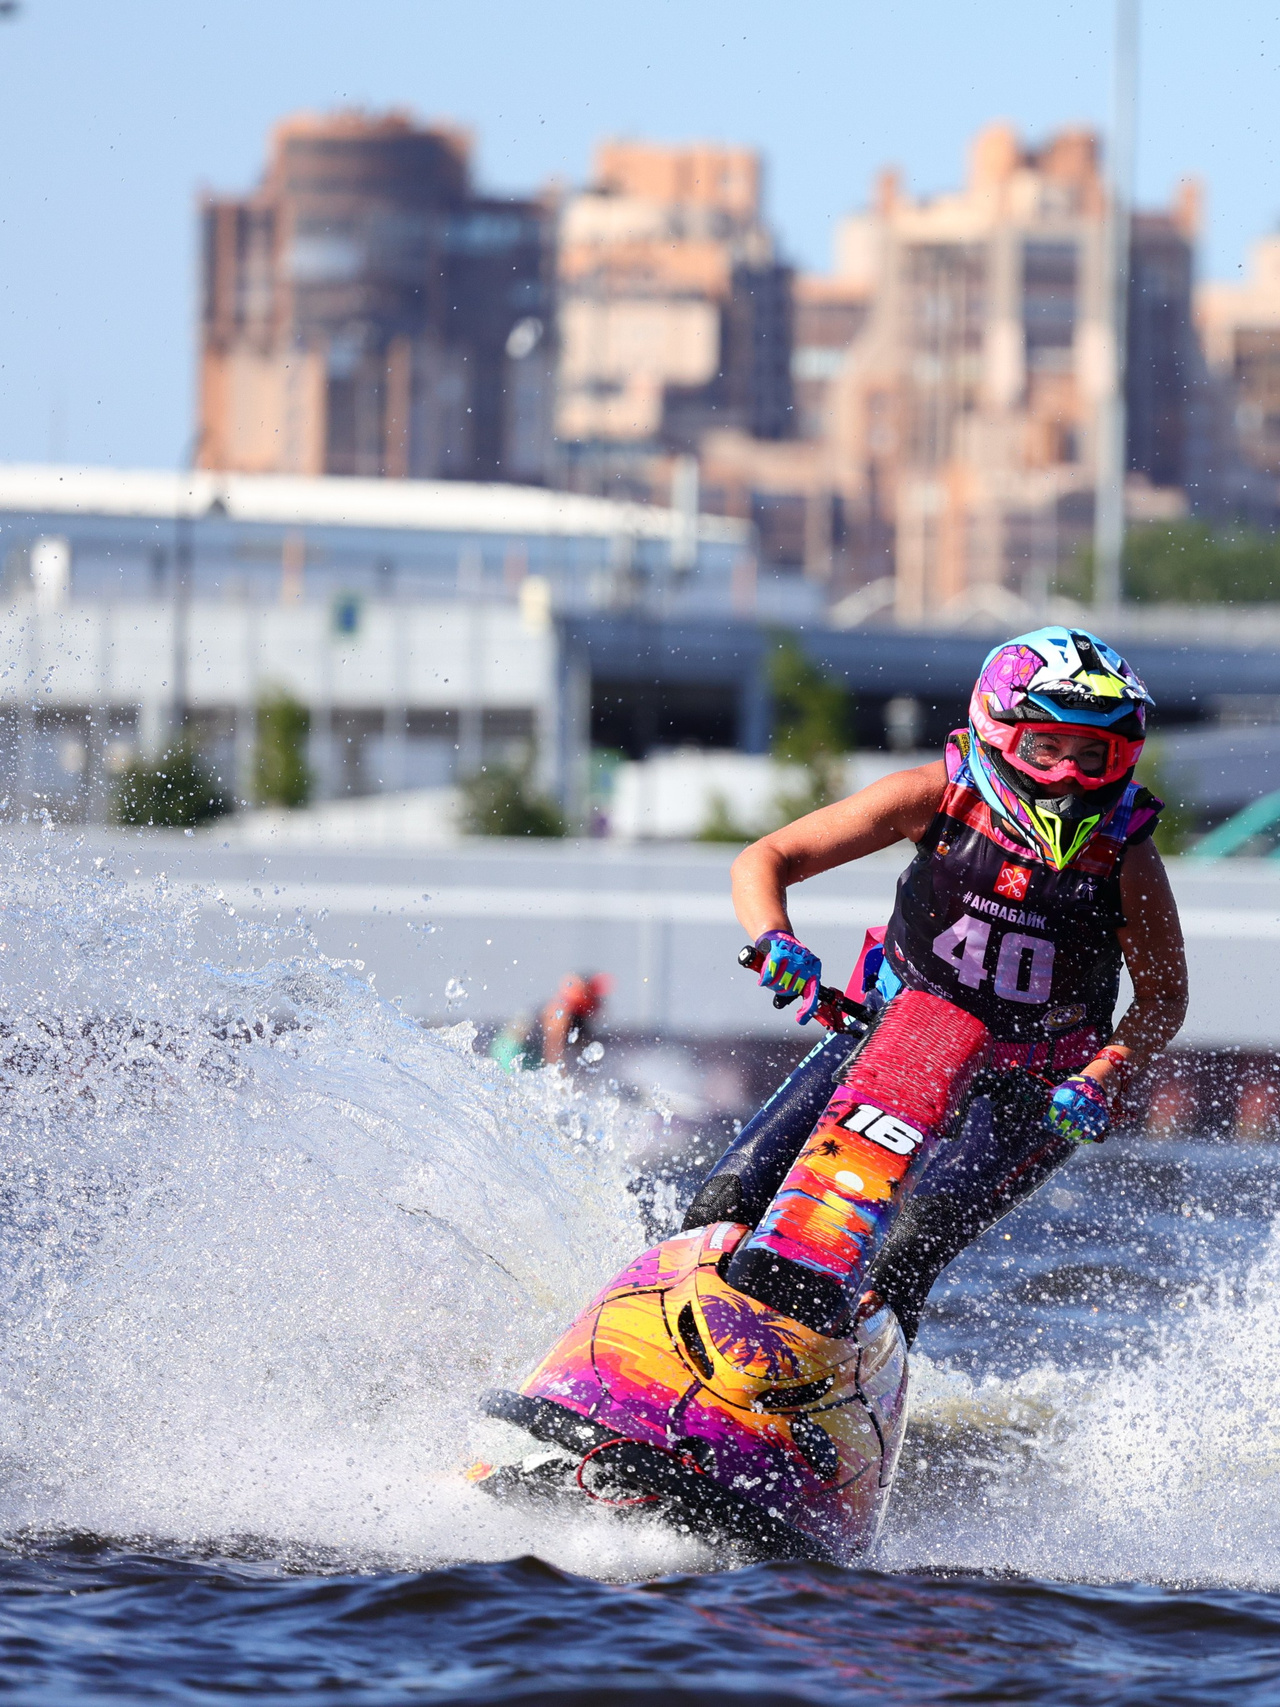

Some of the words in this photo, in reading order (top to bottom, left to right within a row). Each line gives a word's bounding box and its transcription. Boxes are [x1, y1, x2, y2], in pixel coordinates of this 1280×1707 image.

[962, 890, 1048, 930] #АКВАБАЙК
[931, 913, 1056, 1004] 40
[842, 1103, 925, 1155] 16
